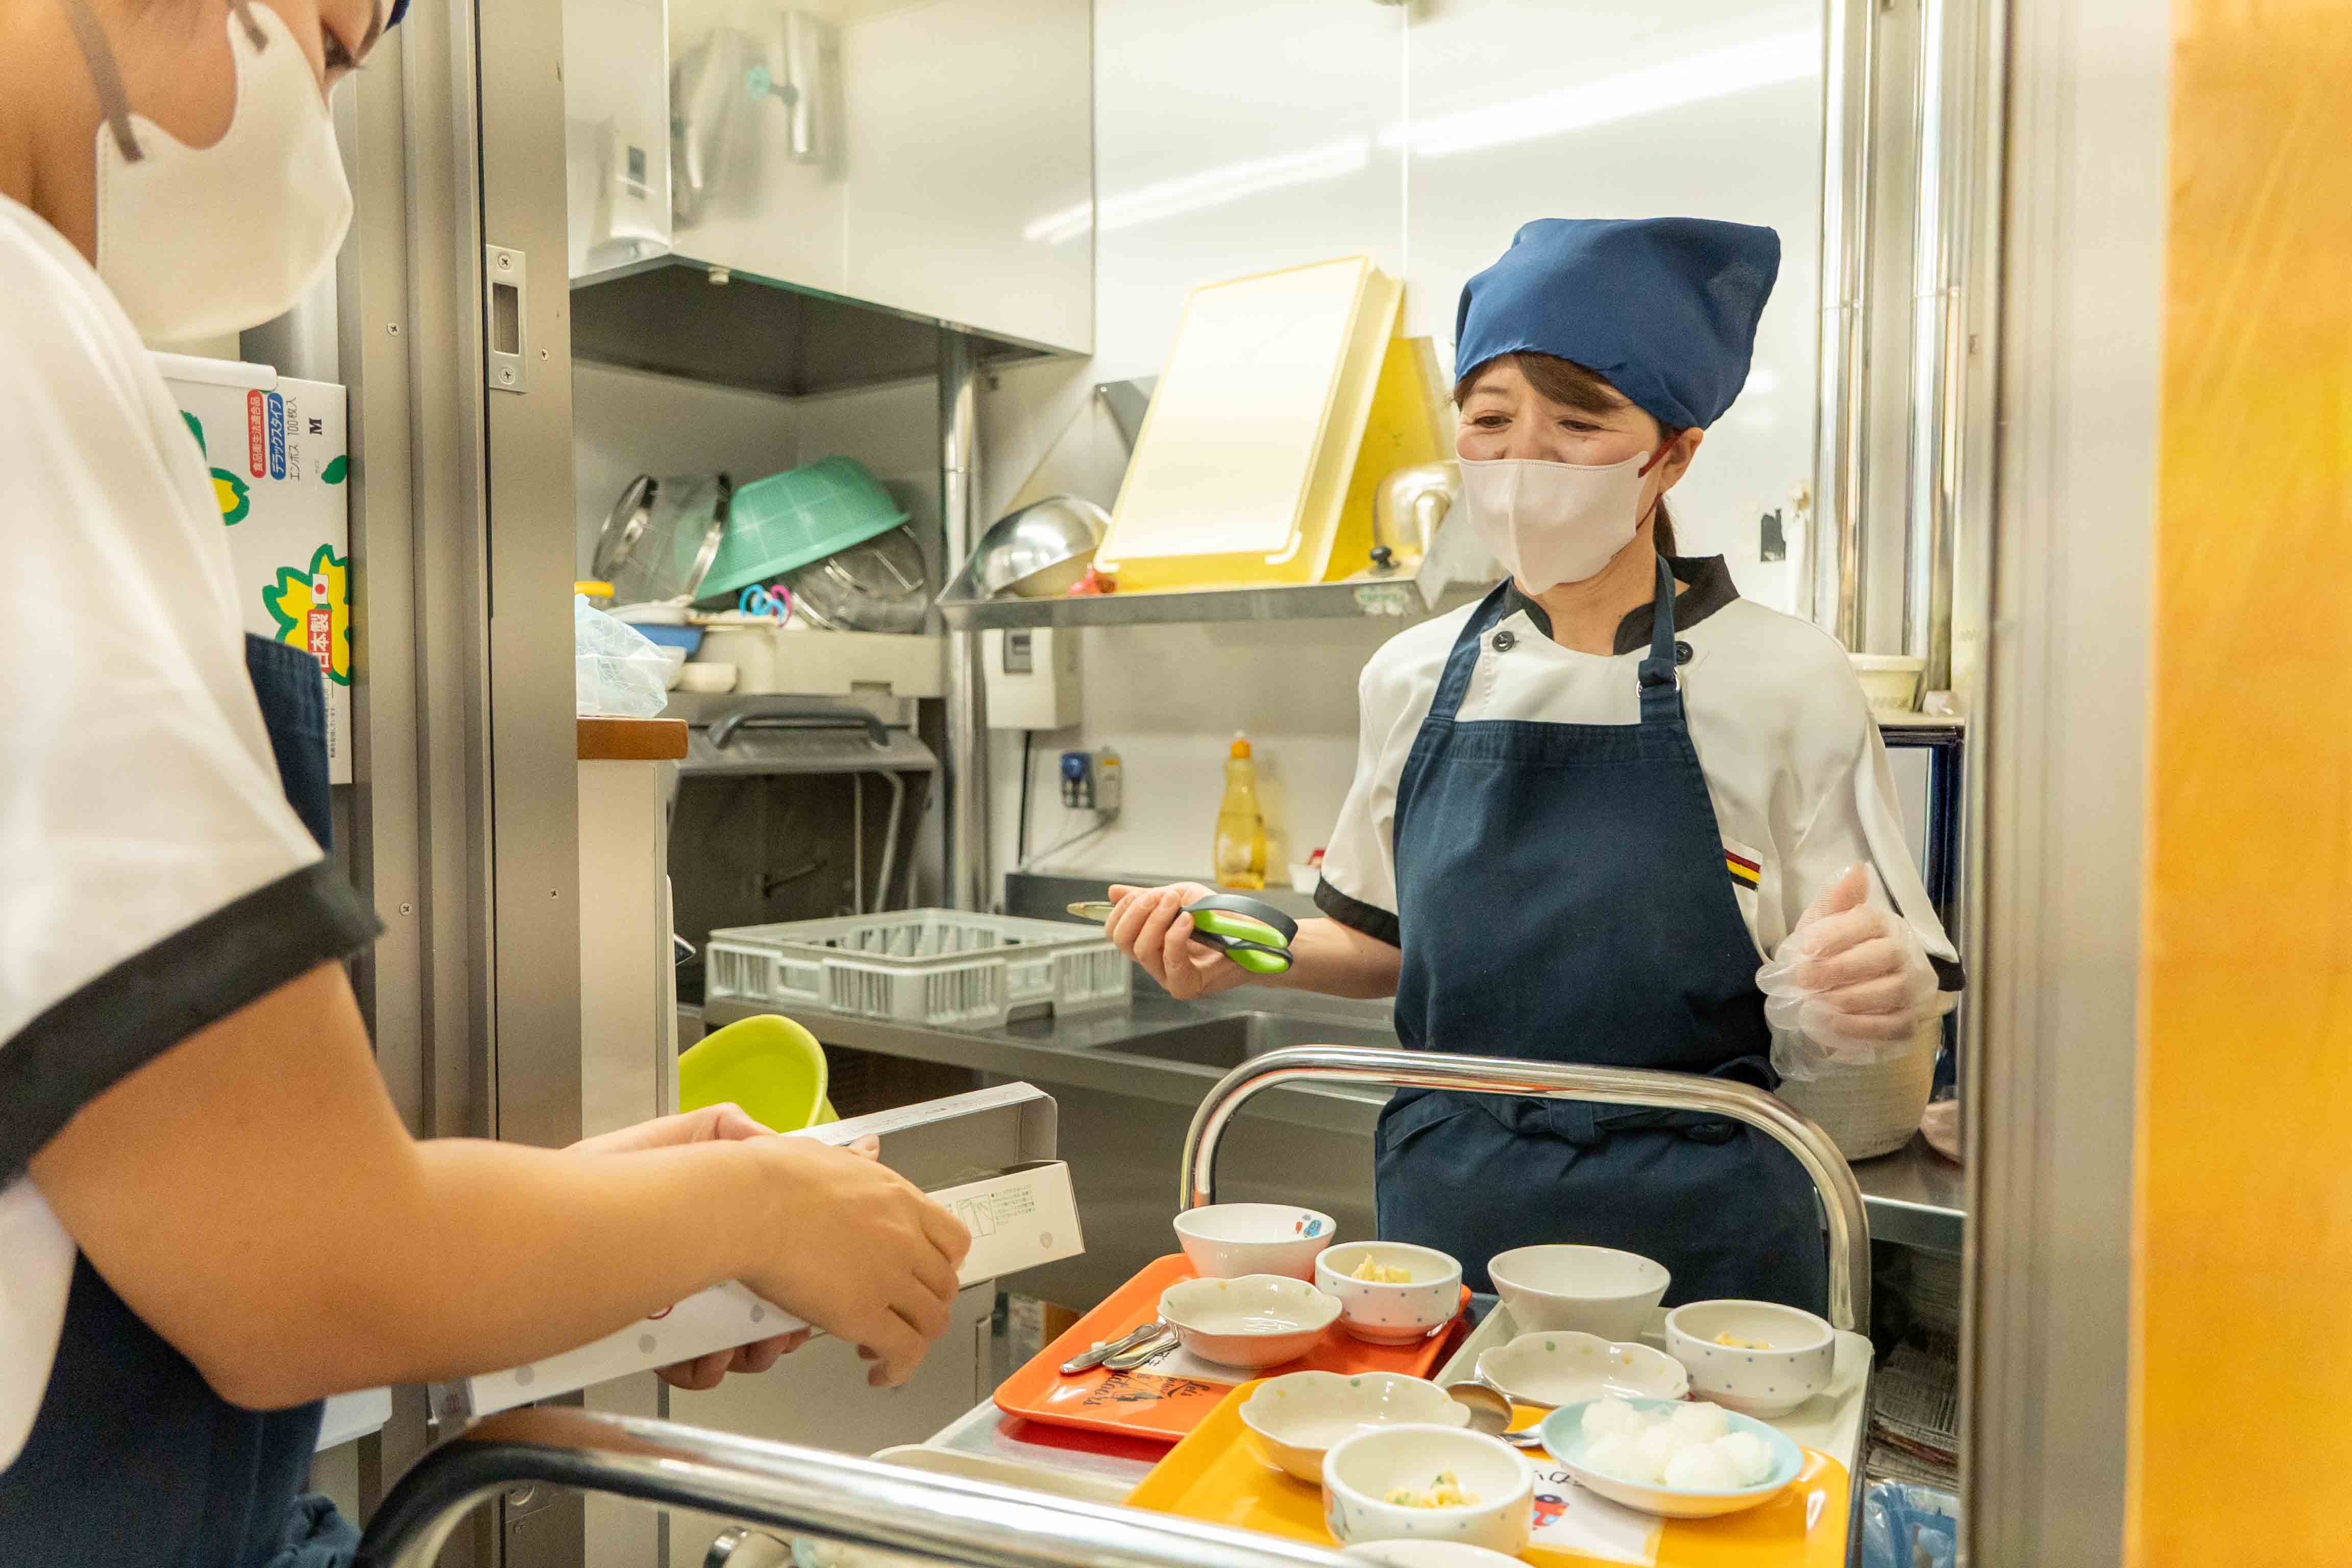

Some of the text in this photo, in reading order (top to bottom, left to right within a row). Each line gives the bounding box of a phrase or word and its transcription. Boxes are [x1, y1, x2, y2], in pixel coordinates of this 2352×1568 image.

[269, 398, 284, 474] デラックスタイプ
[286, 397, 300, 481] エンボス 100枚入
[309, 417, 322, 435] M
[310, 614, 330, 669] 日本製
